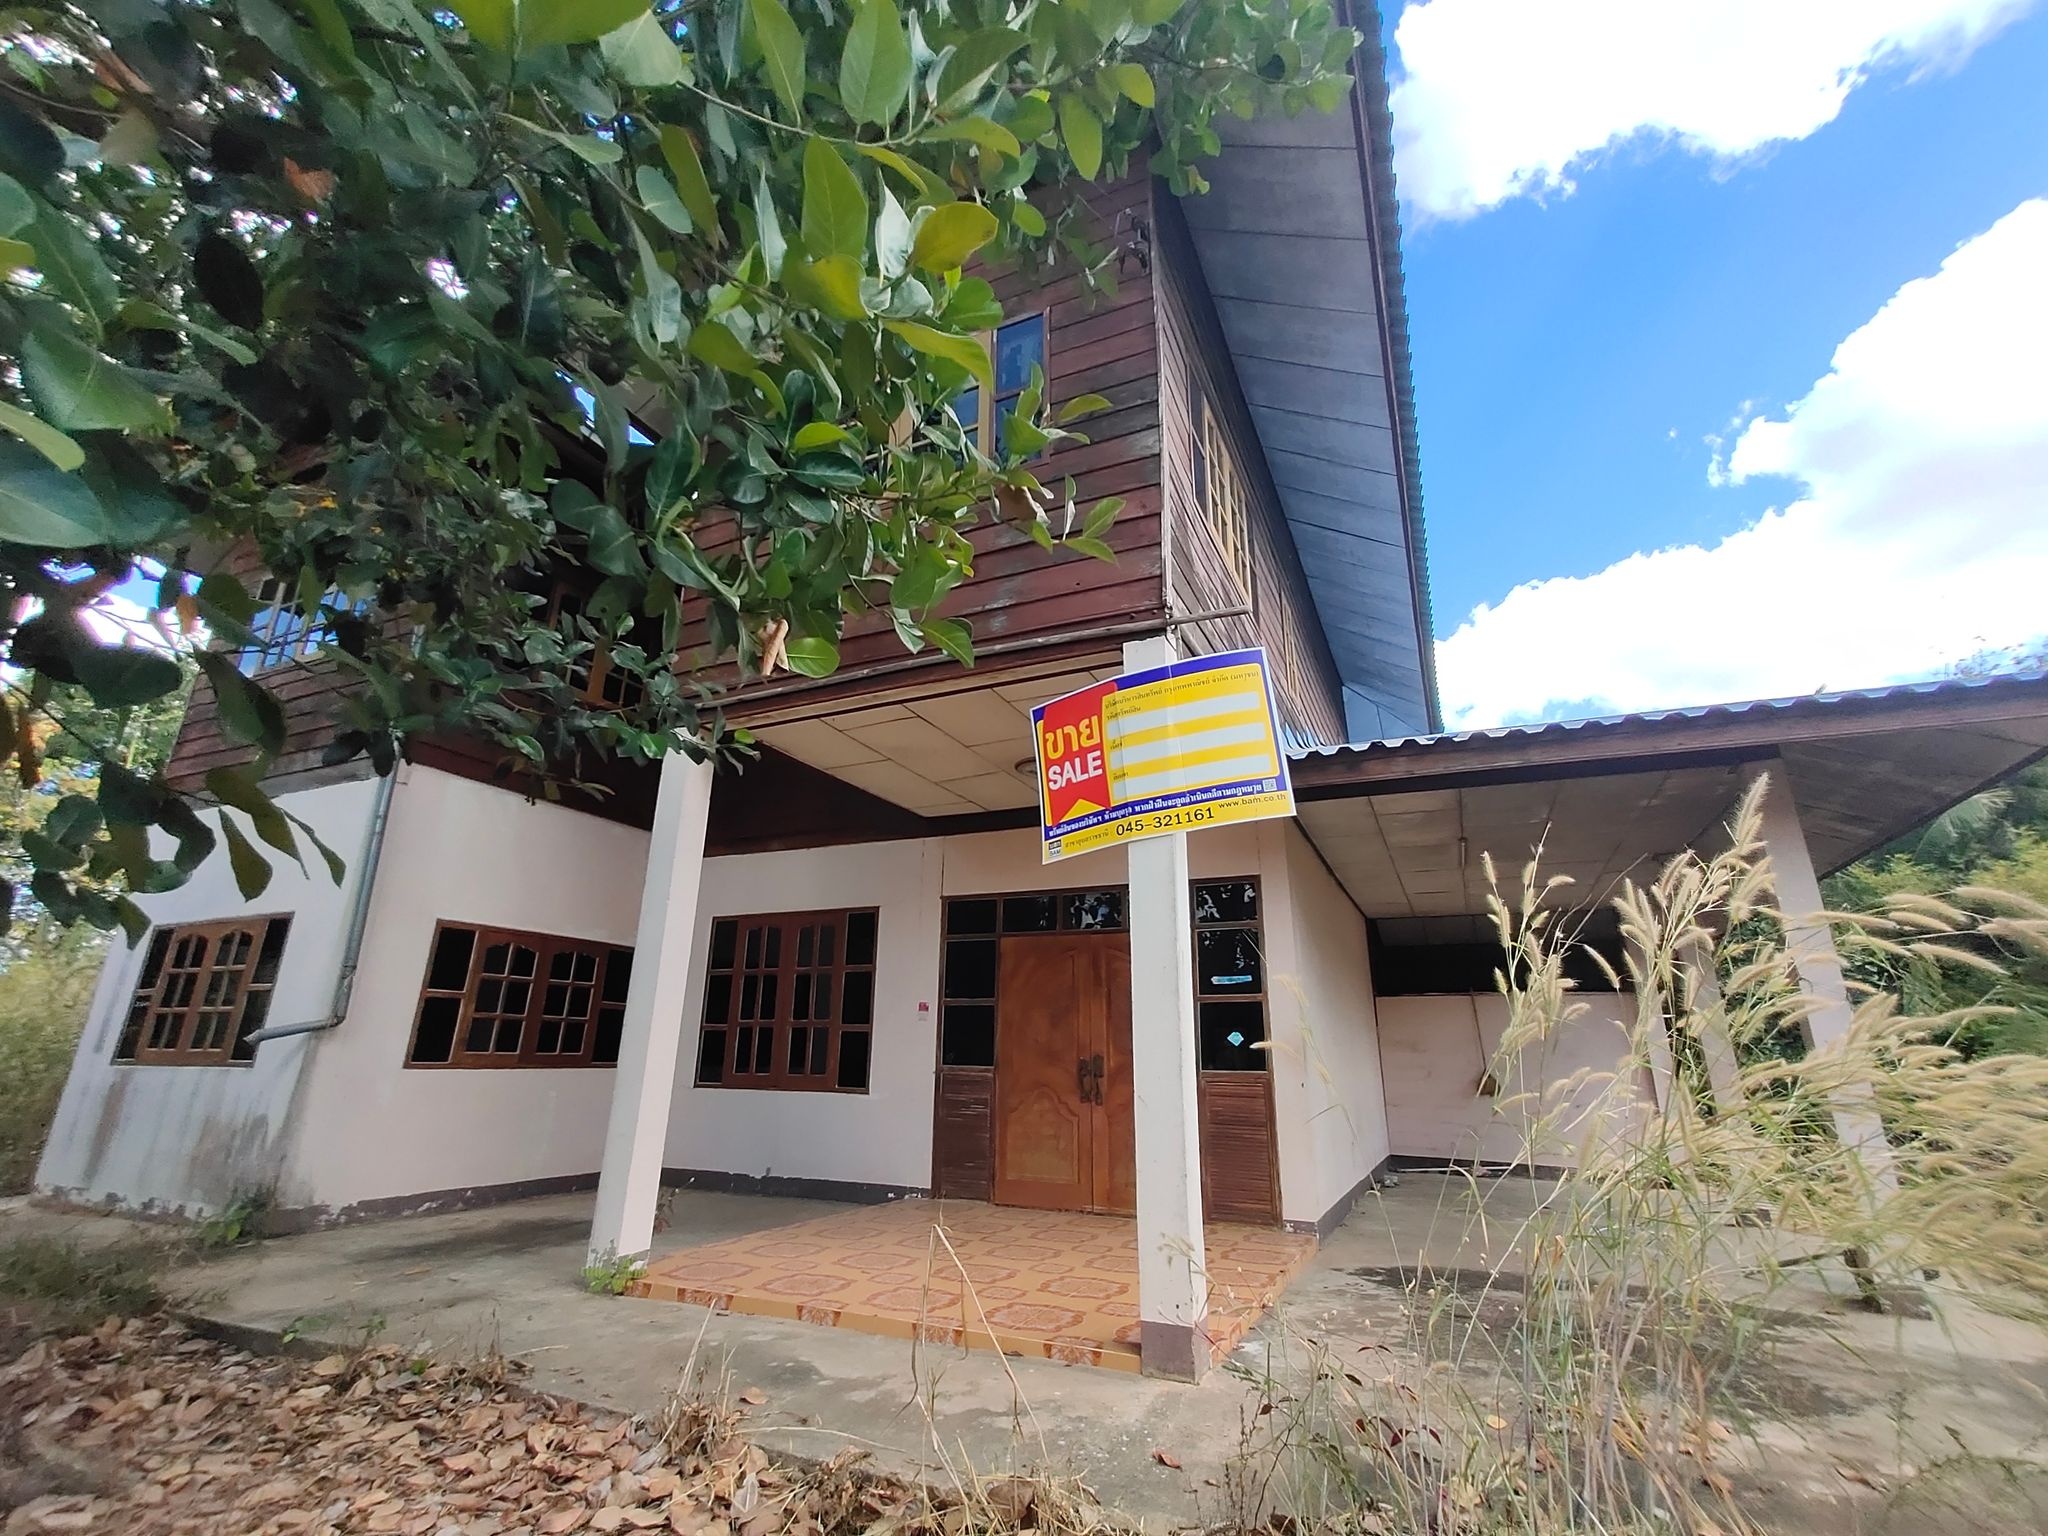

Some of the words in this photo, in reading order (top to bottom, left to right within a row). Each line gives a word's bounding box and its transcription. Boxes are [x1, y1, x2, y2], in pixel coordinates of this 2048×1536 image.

[1045, 715, 1101, 760] ขาย
[1048, 750, 1103, 791] SALE
[1218, 793, 1286, 809] www.bam.co.th
[1116, 807, 1214, 836] 045-321161
